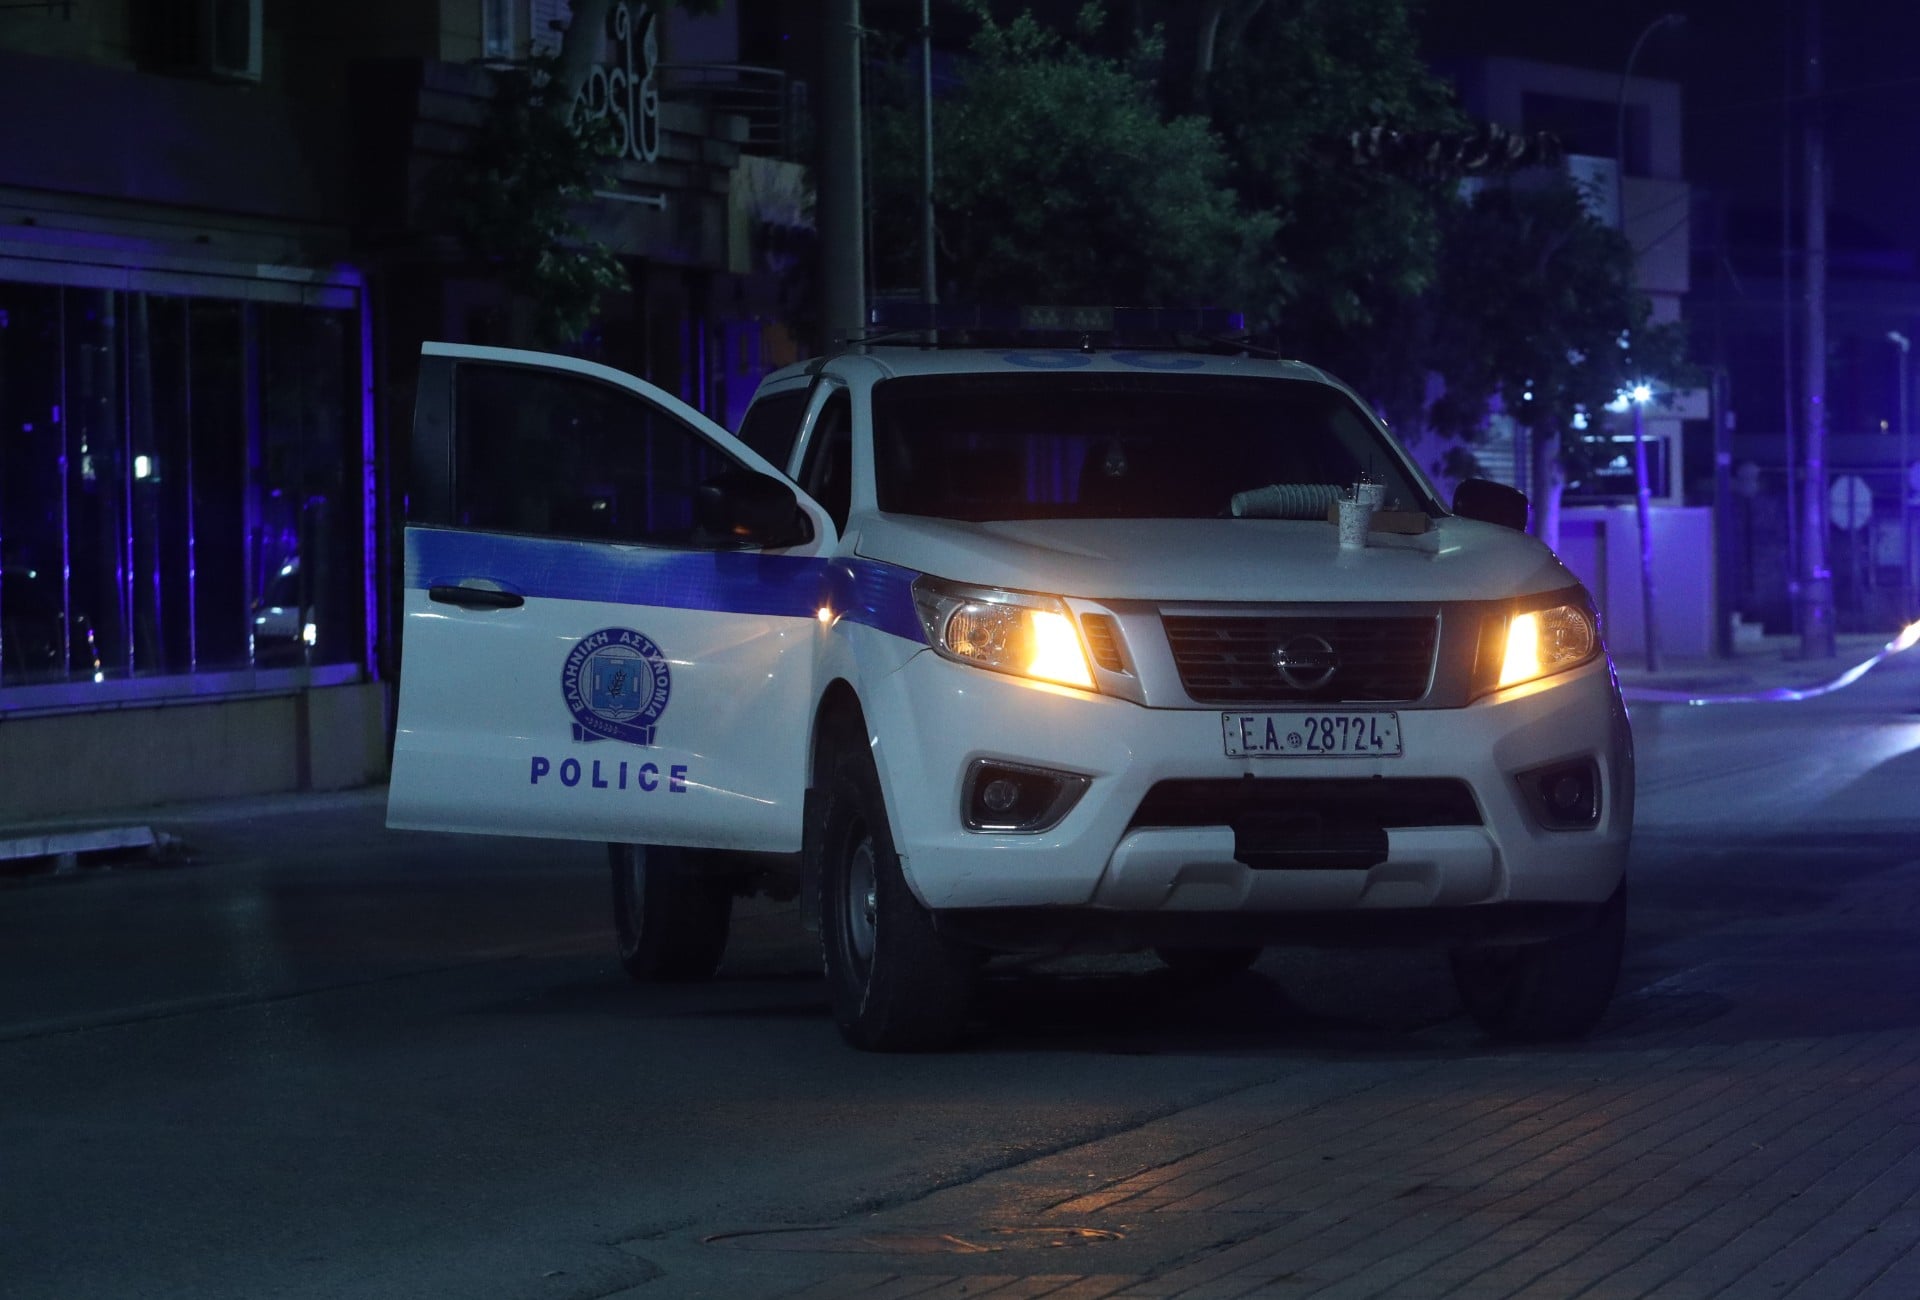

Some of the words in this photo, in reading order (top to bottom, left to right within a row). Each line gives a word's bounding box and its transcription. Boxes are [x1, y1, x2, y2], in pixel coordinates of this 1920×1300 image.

[564, 631, 609, 713] ΕΛΛΗΝΙΚΗ
[619, 631, 669, 718] ΑΣΤΥΝΟΜΙΑ
[1304, 716, 1384, 751] 28724
[530, 756, 688, 793] POLICE
